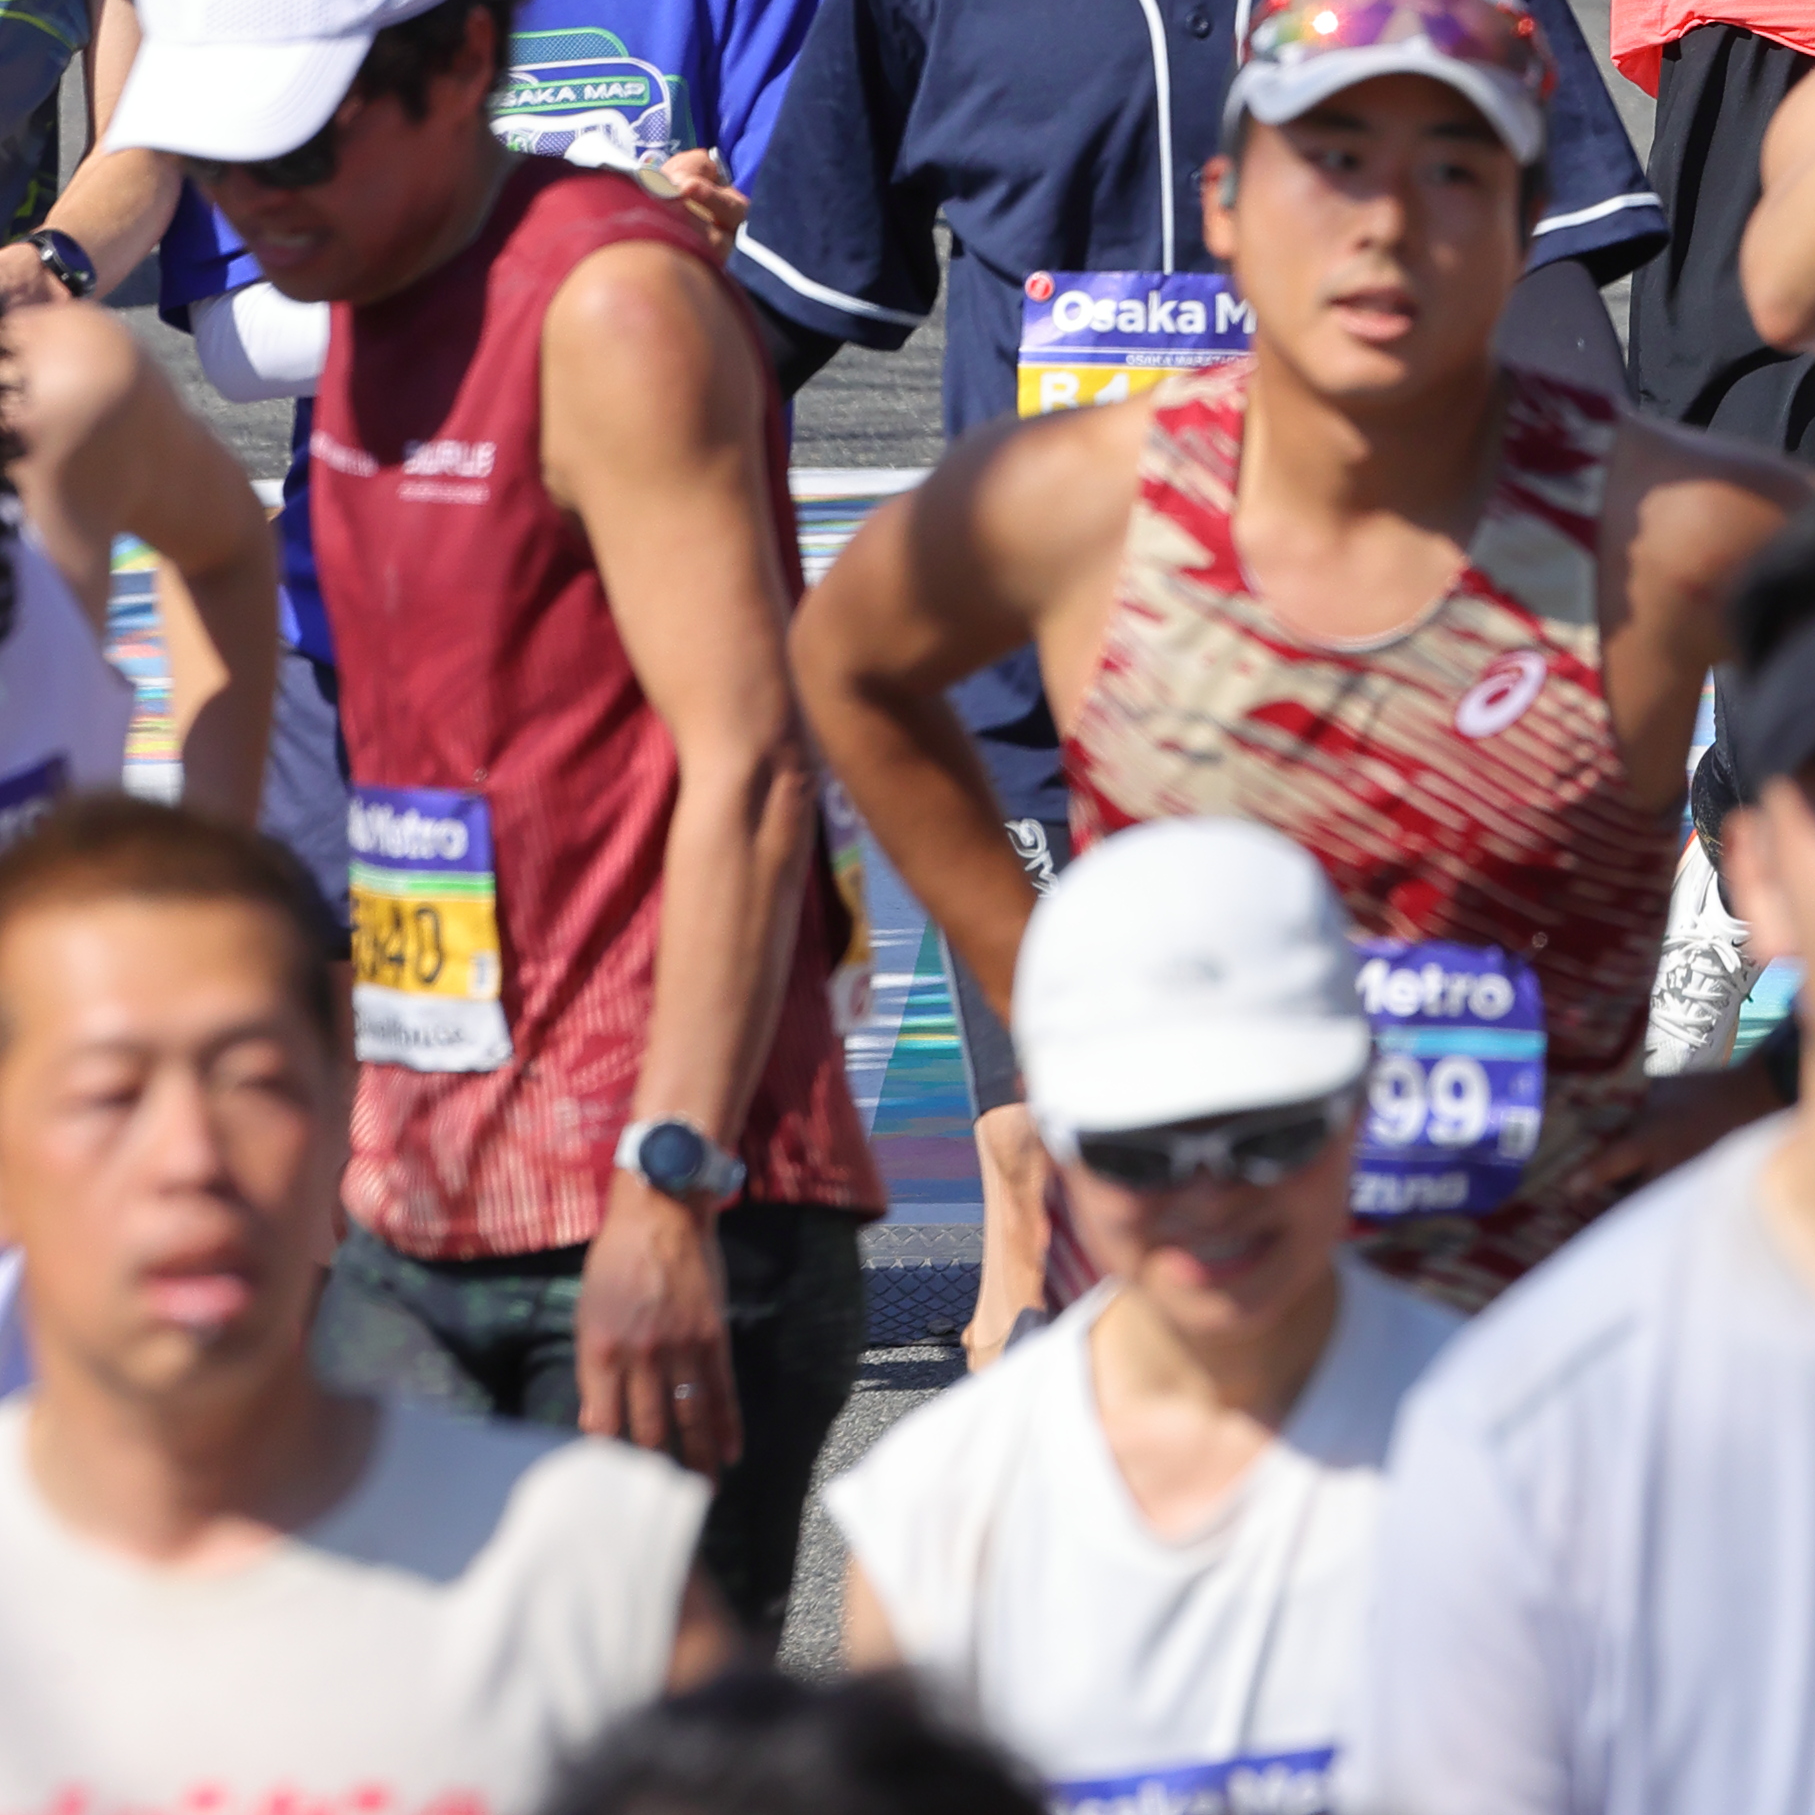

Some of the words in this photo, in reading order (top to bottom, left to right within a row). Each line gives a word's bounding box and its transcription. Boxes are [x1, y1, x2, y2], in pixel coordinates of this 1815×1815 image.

[500, 87, 577, 108] SAKA
[583, 81, 646, 101] MAP
[1052, 289, 1207, 334] Osaka
[1352, 1172, 1471, 1214] ZUNO
